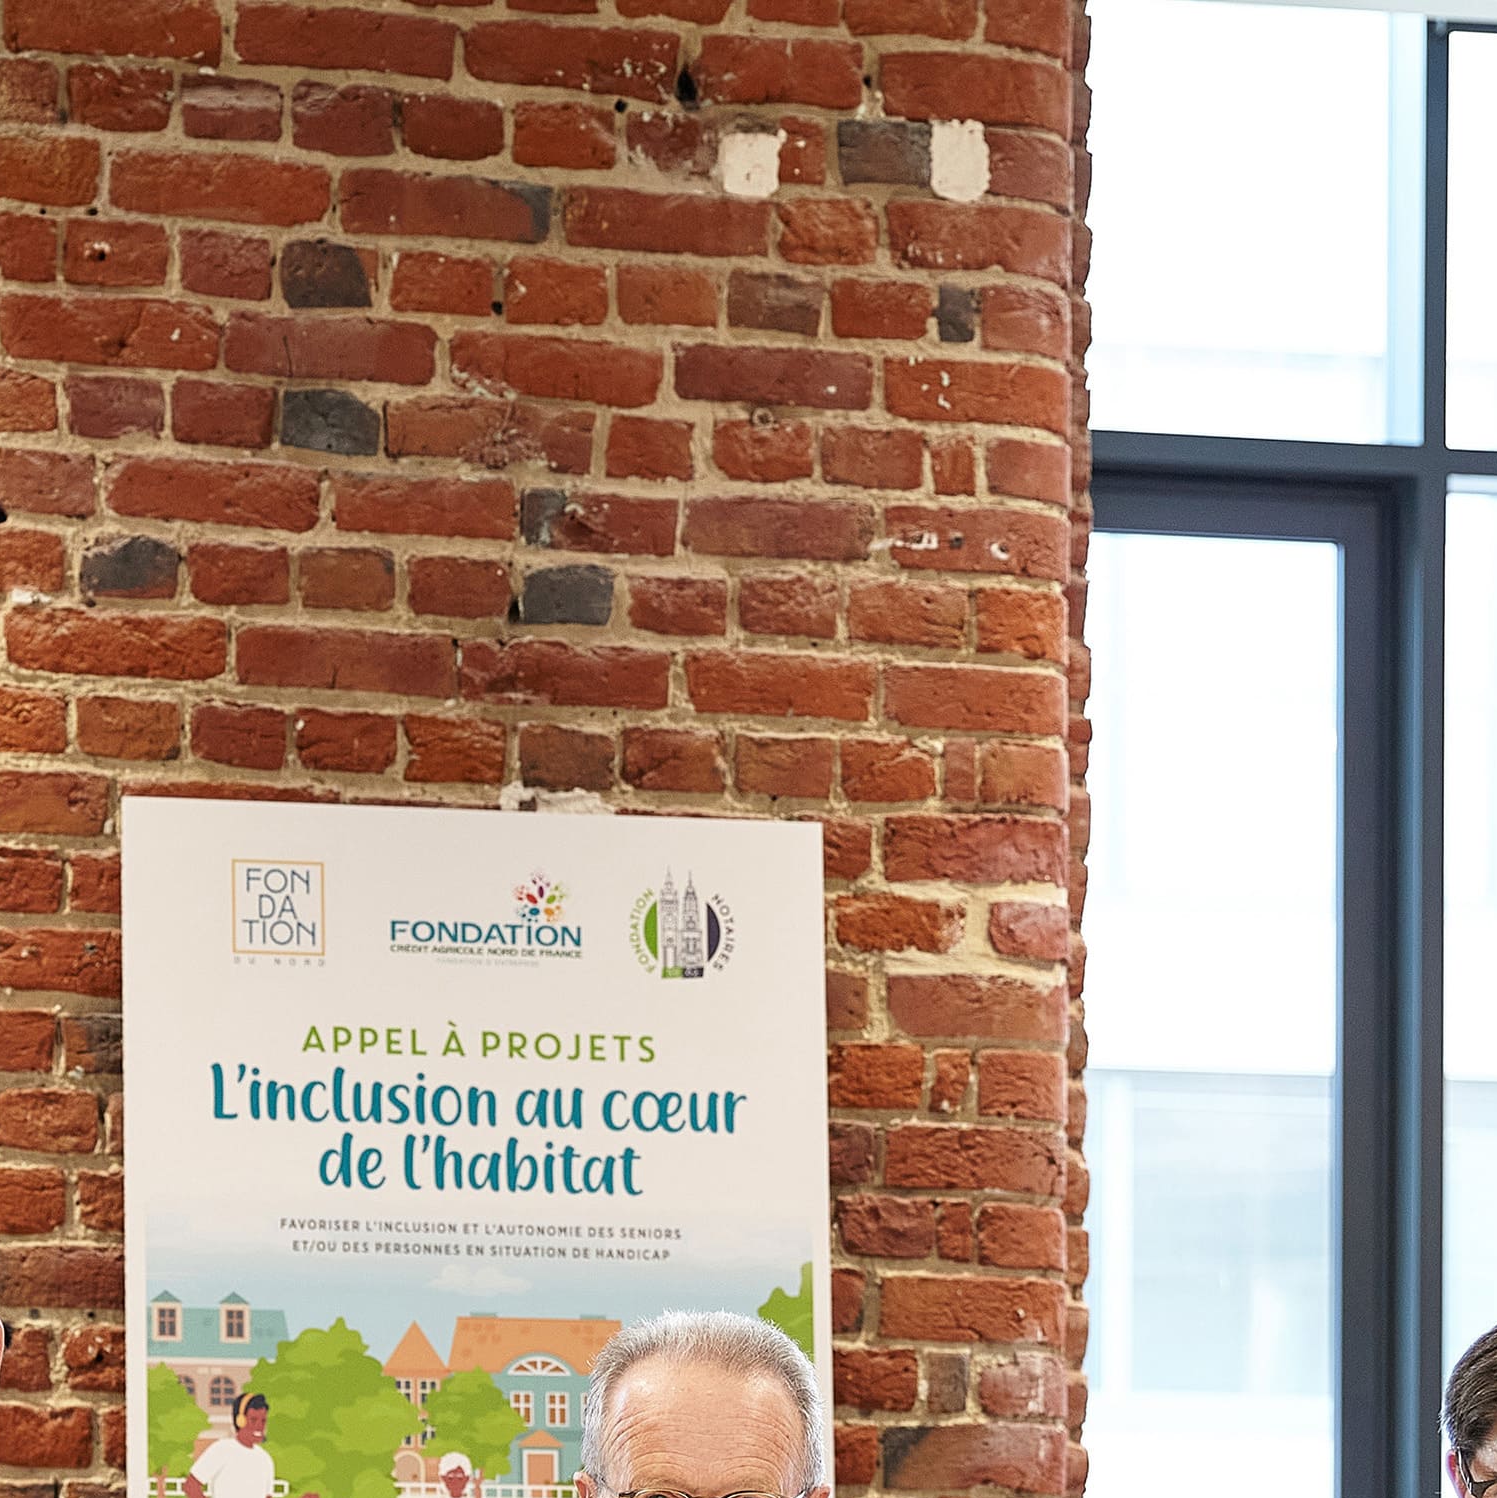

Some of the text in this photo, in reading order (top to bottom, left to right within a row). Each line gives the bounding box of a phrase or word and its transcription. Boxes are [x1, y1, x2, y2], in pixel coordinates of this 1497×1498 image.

[245, 868, 311, 894] FON
[258, 894, 298, 920] DA
[242, 919, 317, 947] TION
[390, 920, 581, 947] FONDATION
[487, 947, 518, 957] NORD
[521, 948, 536, 957] DE
[539, 949, 582, 960] FRANCE
[302, 1020, 656, 1063] APPEL À PROJETS
[211, 1062, 748, 1135] L'inclusion au cœur
[319, 1132, 644, 1197] de l'habitat
[280, 1218, 682, 1240] FAVORISER L'INCLUSION ET L'AUTONOMIE DES SENIORS
[292, 1240, 670, 1261] ET/OU DES PERSONNES EN SITUATION DE HANDICAP
